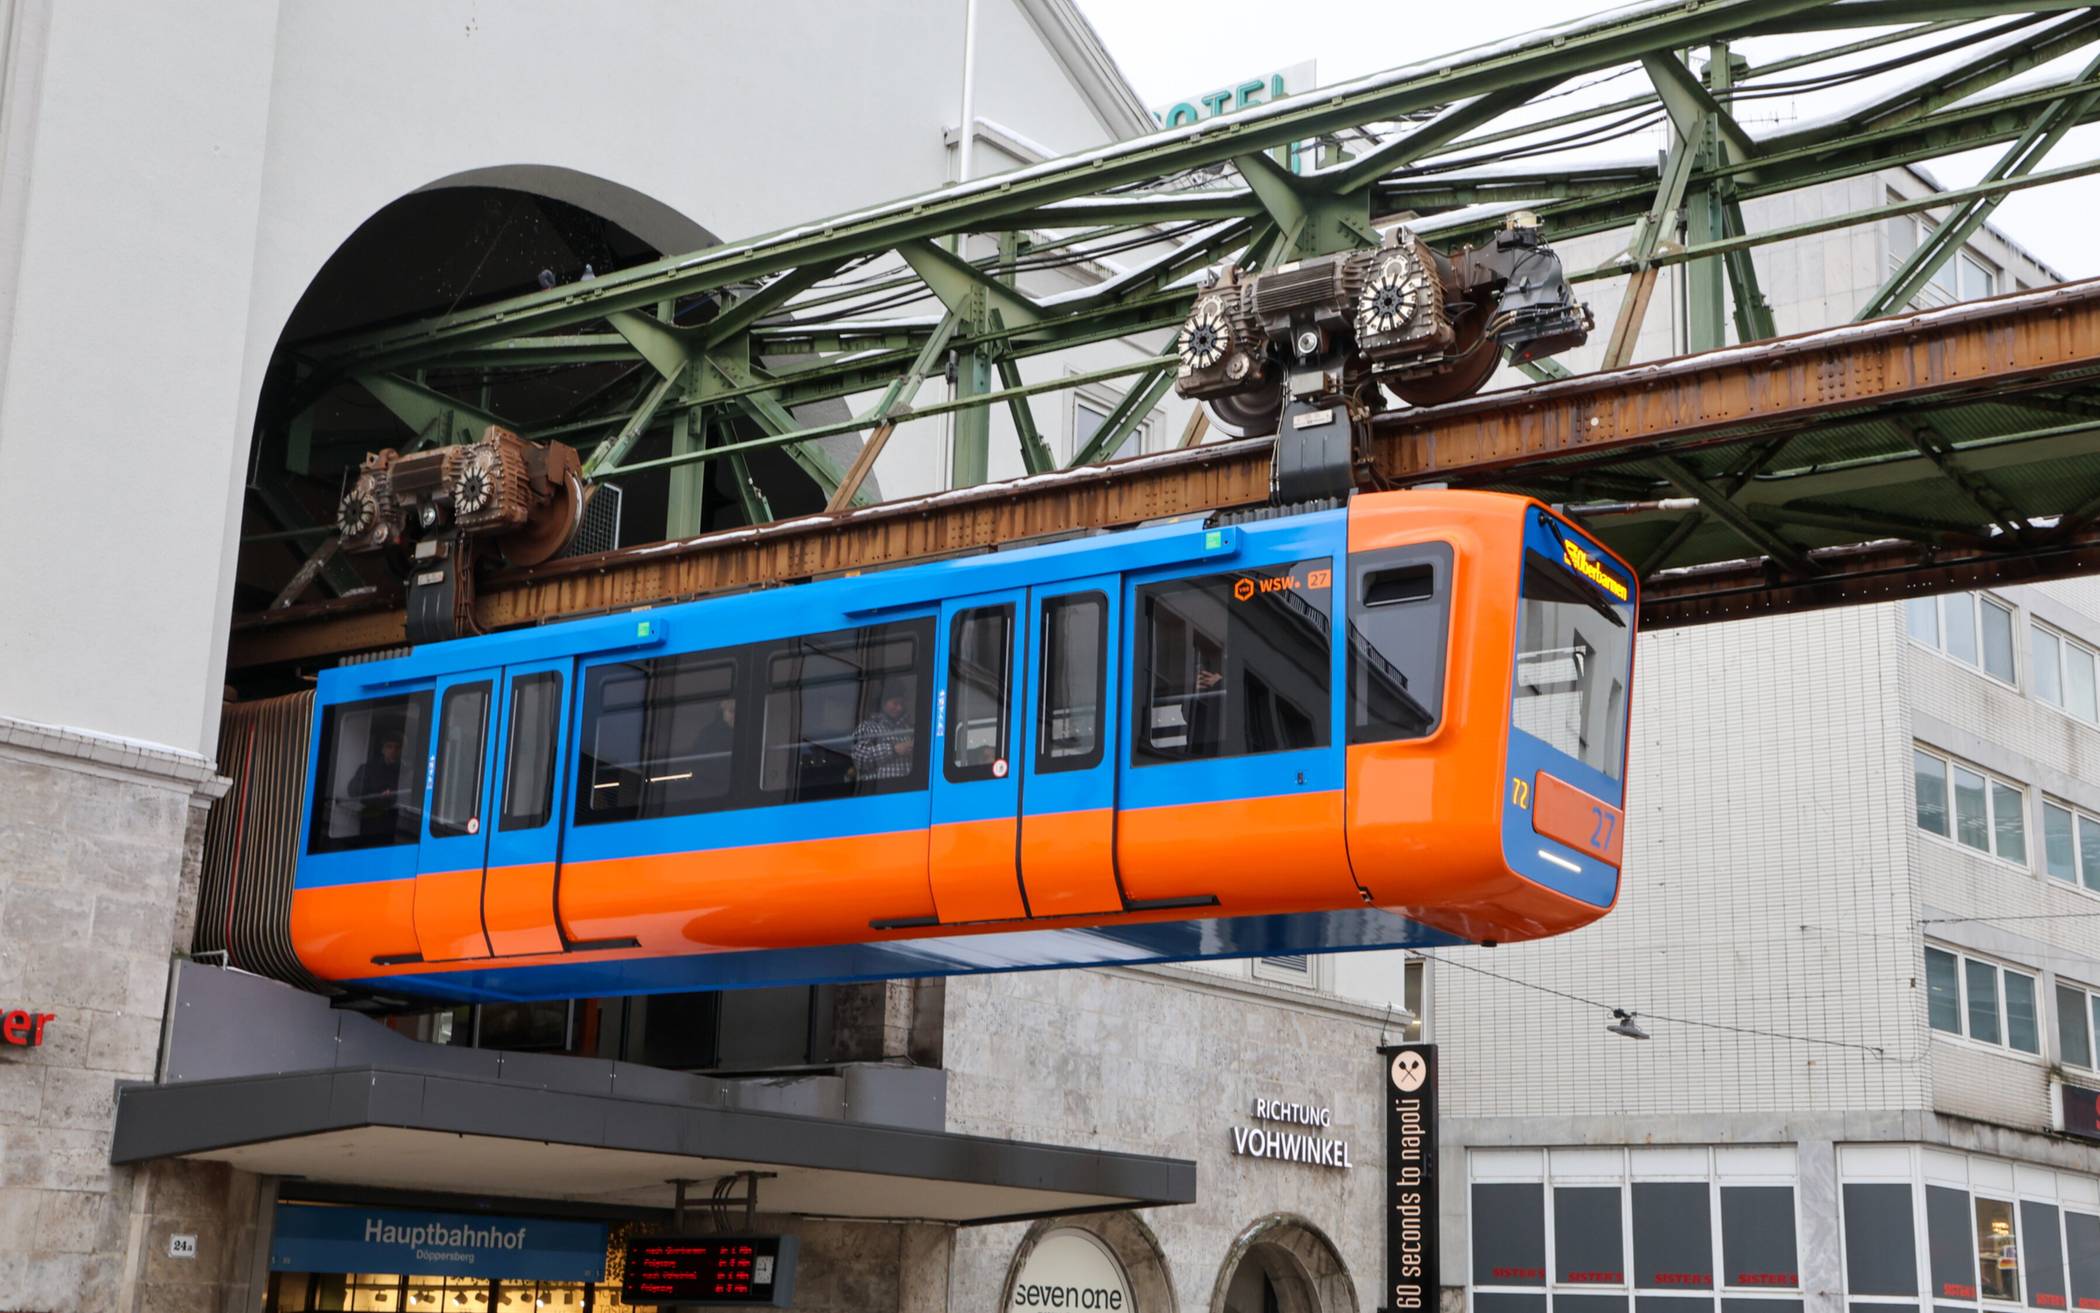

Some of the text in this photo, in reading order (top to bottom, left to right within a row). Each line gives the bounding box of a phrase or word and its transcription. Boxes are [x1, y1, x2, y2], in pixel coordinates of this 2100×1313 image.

[1152, 73, 1284, 127] OTE
[1310, 573, 1328, 586] 27
[1590, 806, 1616, 852] 27
[0, 1008, 56, 1047] er
[1256, 1098, 1330, 1128] RICHTUNG
[1234, 1126, 1353, 1168] VOHWINKEL
[1395, 1099, 1426, 1308] 60 seconds to napoli
[364, 1218, 526, 1250] Hauptbahnhof
[416, 1249, 474, 1264] Döppersberg
